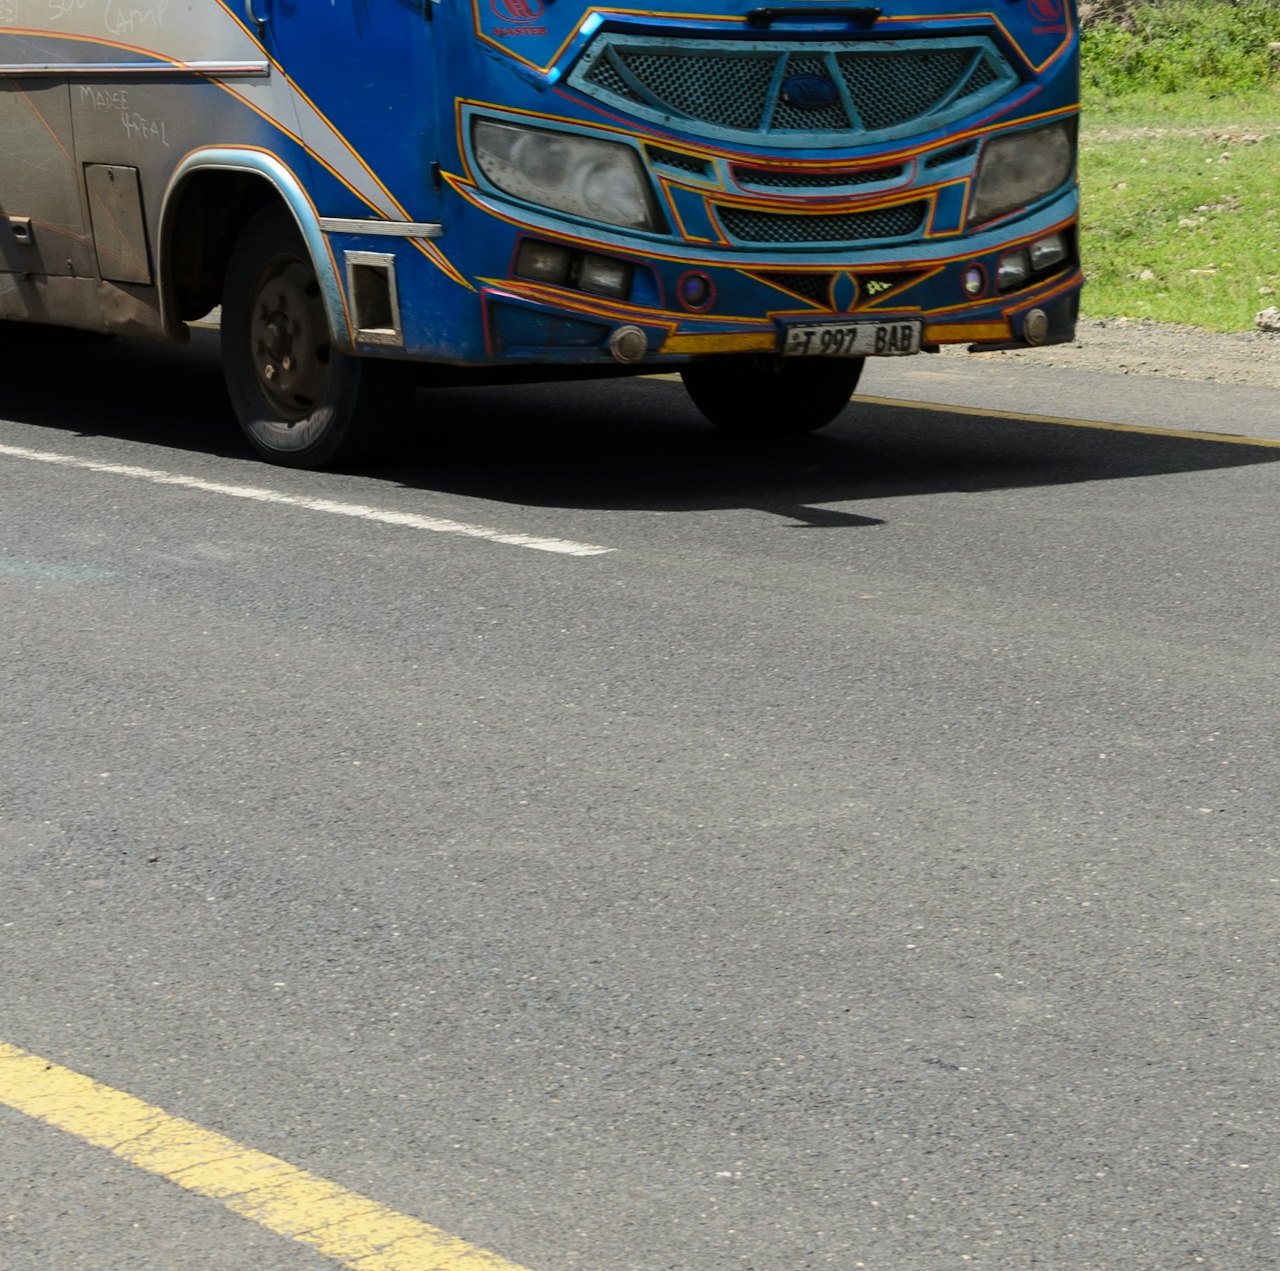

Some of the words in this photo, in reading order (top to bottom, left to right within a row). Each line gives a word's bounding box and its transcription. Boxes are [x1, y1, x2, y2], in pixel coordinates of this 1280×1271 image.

[803, 331, 816, 354] T
[820, 328, 858, 354] 997
[874, 325, 914, 353] BAB
